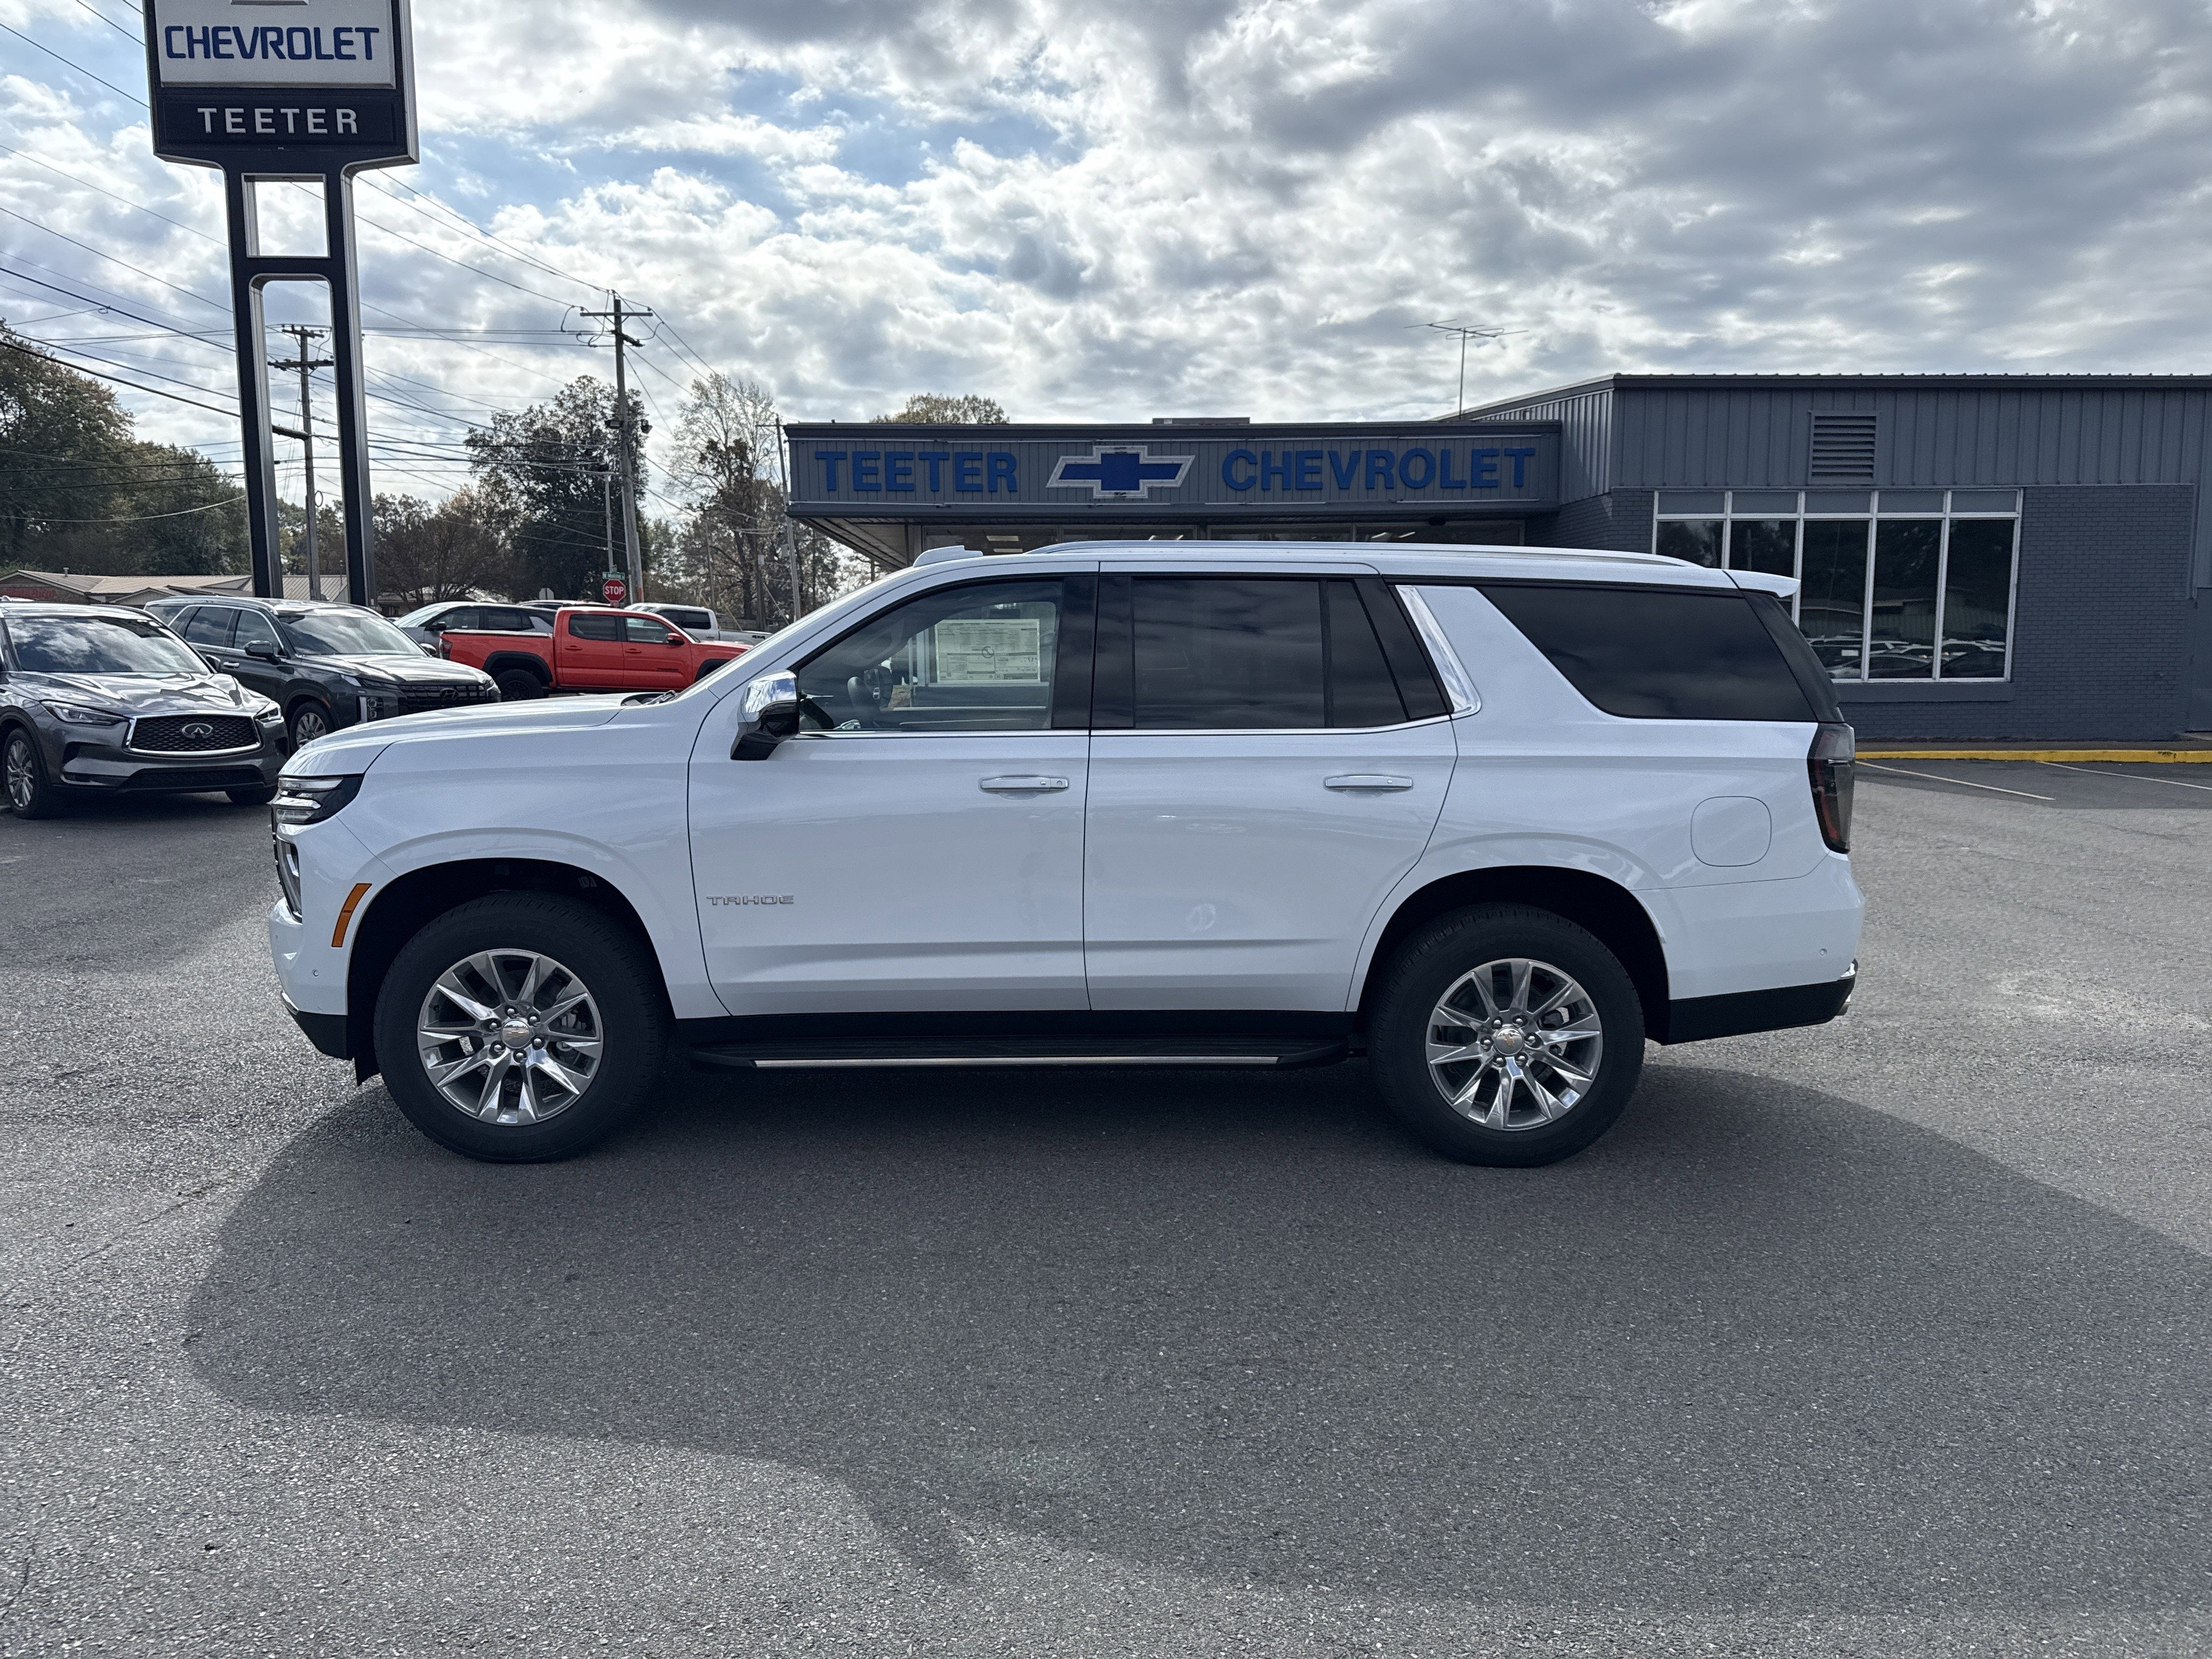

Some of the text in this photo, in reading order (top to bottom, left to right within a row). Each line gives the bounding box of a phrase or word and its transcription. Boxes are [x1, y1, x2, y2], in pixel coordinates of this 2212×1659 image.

[165, 25, 380, 60] CHEVROLET
[197, 107, 358, 134] TEETER
[815, 447, 1536, 492] TEETER CHEVROLET
[605, 586, 624, 595] STOP
[706, 895, 794, 906] TAHOE
